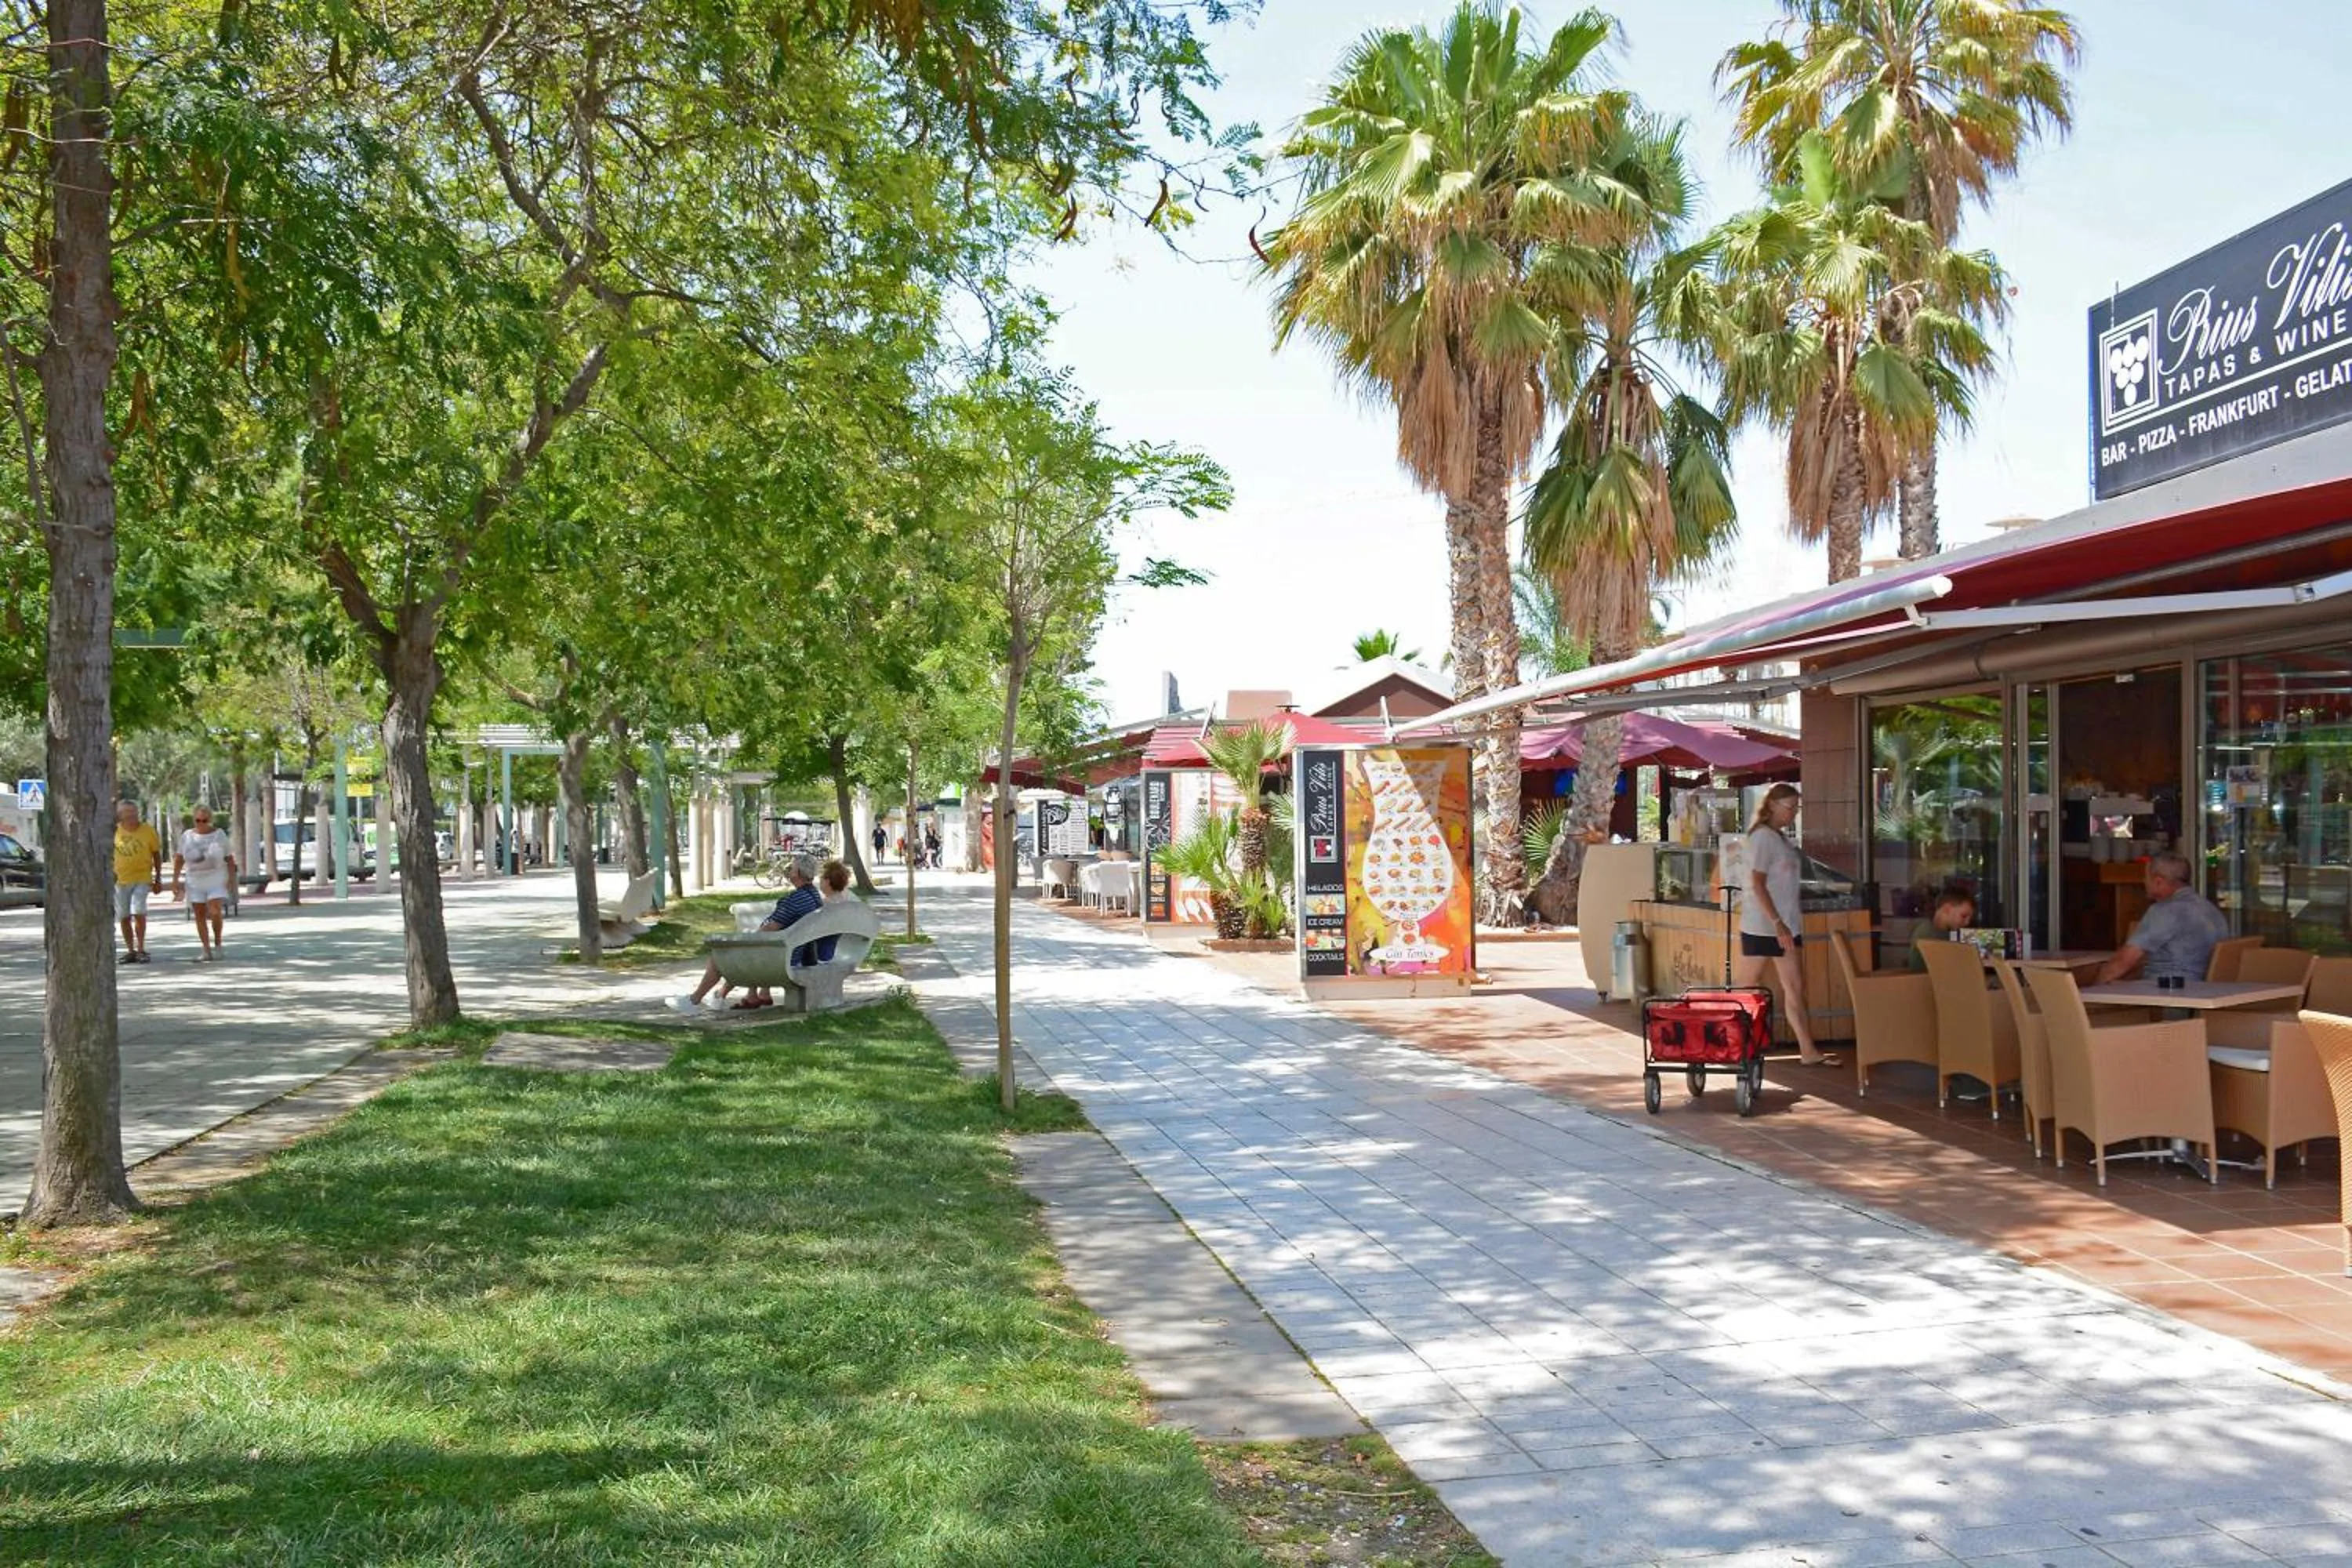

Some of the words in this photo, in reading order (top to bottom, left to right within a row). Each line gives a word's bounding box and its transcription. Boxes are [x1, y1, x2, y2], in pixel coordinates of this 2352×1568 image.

[2165, 353, 2236, 399] TAPAS
[2249, 346, 2262, 364] &
[2276, 308, 2347, 354] WINE
[2101, 442, 2127, 466] BAR
[2139, 426, 2177, 454] PIZZA
[2188, 384, 2279, 437] FRANKFURT
[2296, 359, 2352, 399] GELAT
[1307, 953, 1345, 962] COCKTAILS
